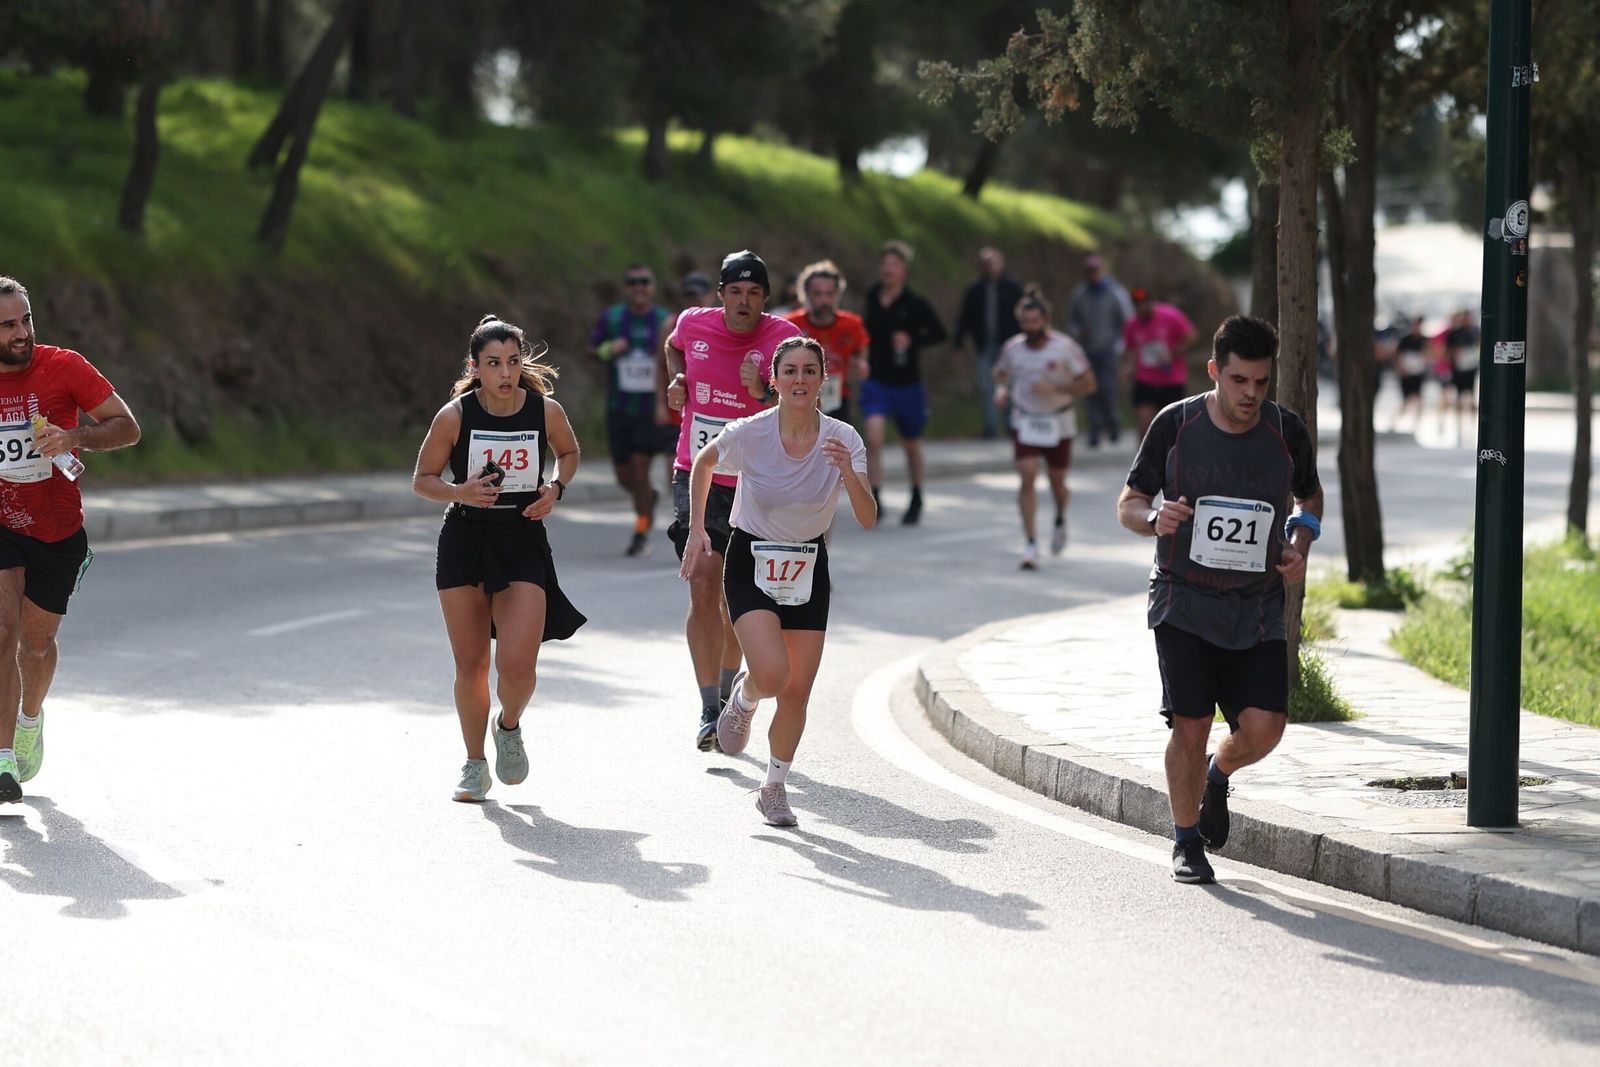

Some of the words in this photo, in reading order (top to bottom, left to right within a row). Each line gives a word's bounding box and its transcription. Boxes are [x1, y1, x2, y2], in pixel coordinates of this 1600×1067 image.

[712, 396, 722, 404] de
[722, 397, 747, 409] Málaga
[713, 389, 737, 400] Ciudad
[482, 448, 529, 471] 143
[1207, 516, 1258, 545] 621
[766, 559, 807, 582] 117
